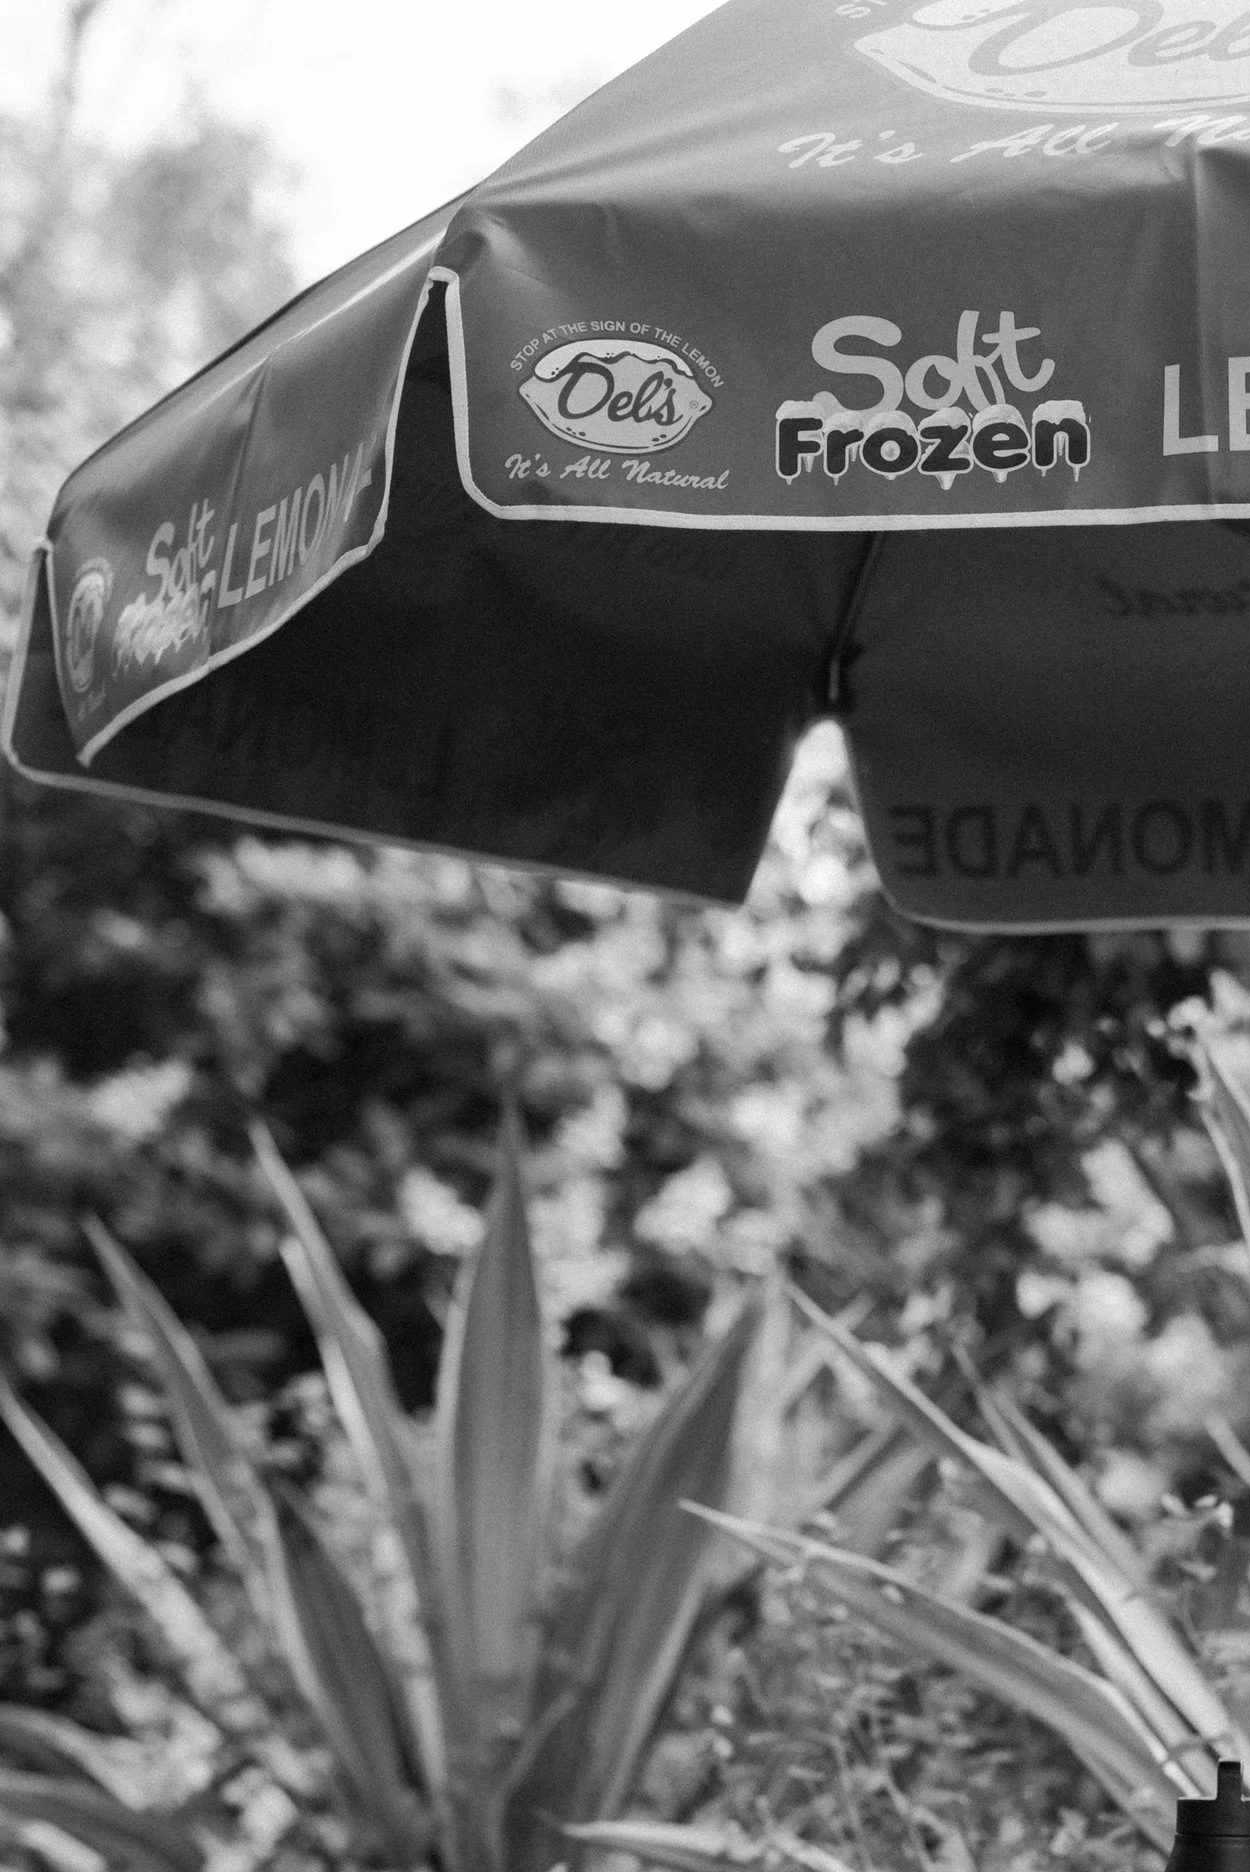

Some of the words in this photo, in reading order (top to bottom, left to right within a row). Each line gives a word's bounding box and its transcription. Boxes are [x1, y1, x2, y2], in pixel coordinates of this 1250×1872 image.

[777, 129, 923, 169] It's
[950, 122, 1120, 164] All
[510, 337, 542, 372] STOP
[541, 328, 557, 345] AT
[558, 320, 588, 335] THE
[590, 320, 626, 332] SIGN
[629, 322, 651, 335] OF
[653, 327, 682, 348] THE
[681, 342, 725, 388] LEMON
[811, 309, 1057, 420] Soft
[504, 453, 551, 479] It's
[559, 455, 612, 480] All
[621, 459, 730, 490] Natural
[775, 401, 1092, 482] Frozen
